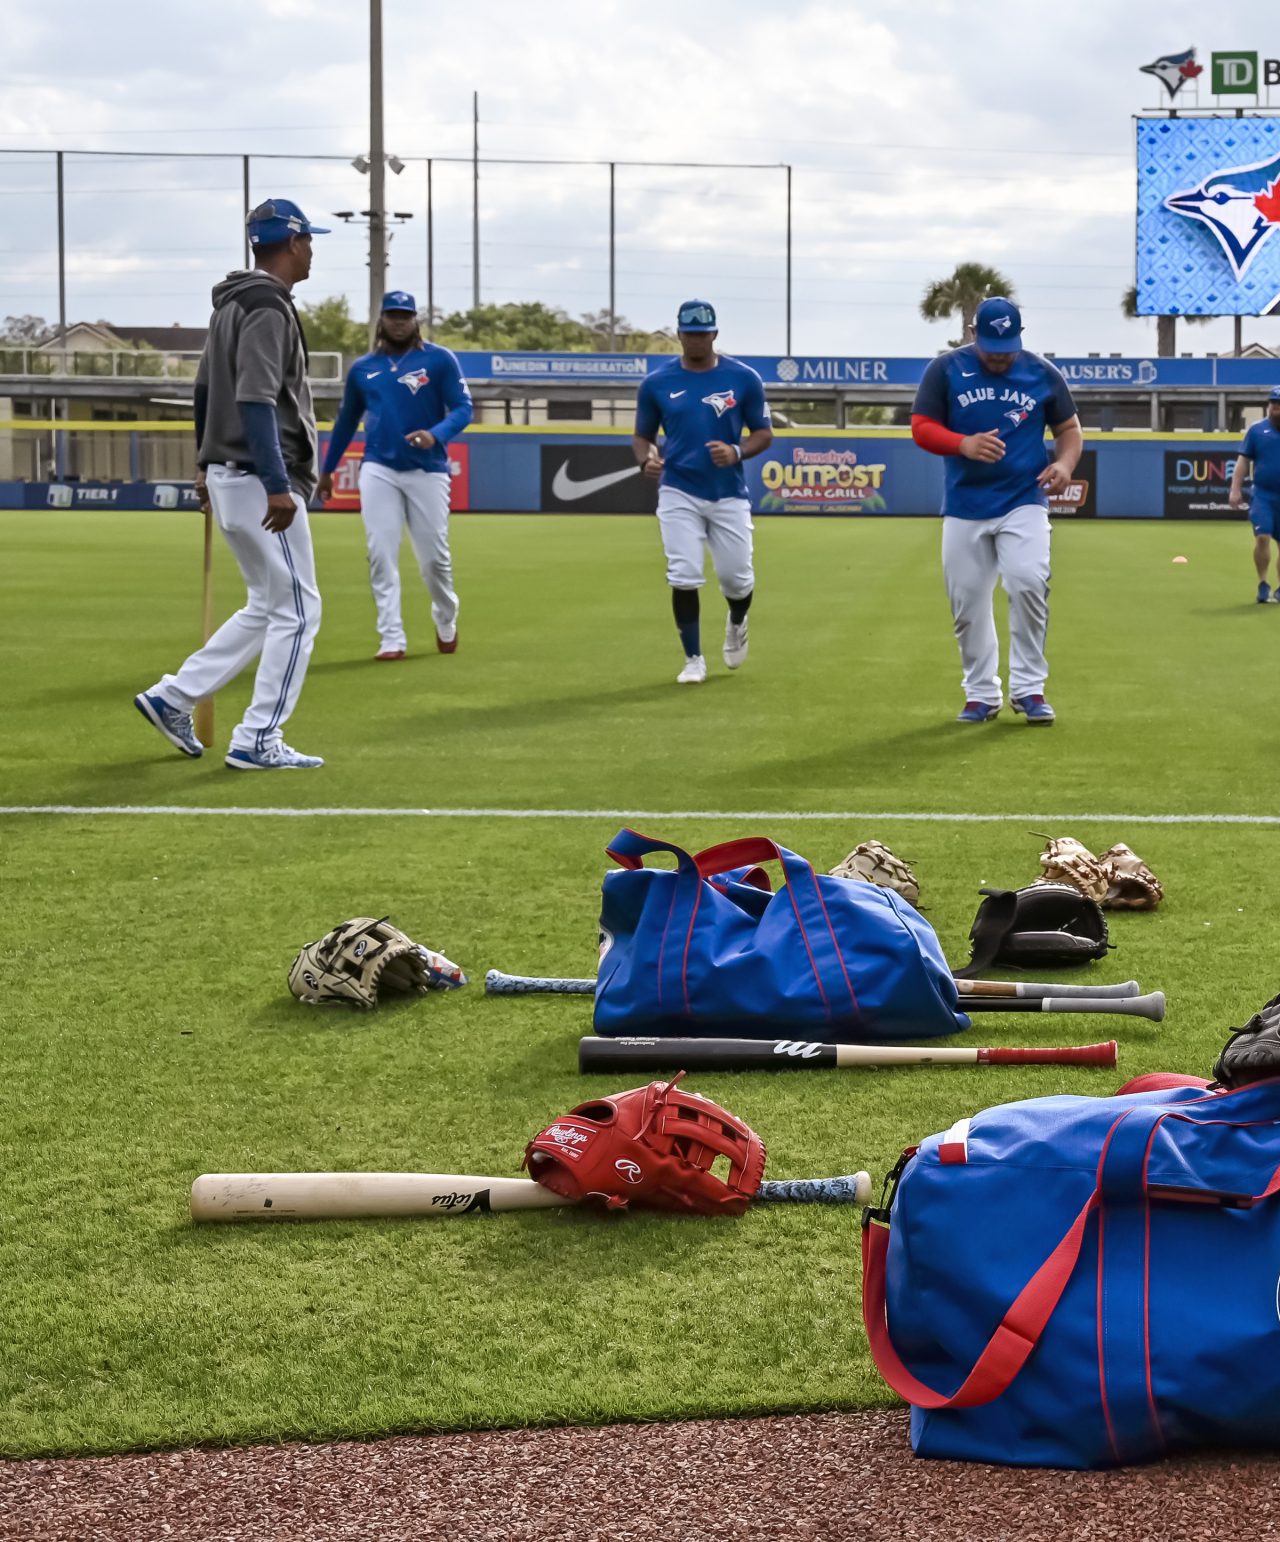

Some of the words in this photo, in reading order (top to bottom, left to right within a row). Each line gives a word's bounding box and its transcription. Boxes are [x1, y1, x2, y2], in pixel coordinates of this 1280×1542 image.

[1216, 58, 1253, 86] TD
[803, 360, 888, 381] MILNER
[1060, 364, 1132, 380] AUSER'S
[957, 387, 996, 408] BLUE
[999, 389, 1036, 411] JAYS
[761, 460, 887, 490] OUTPOST
[76, 489, 109, 500] TIER
[111, 488, 118, 500] 1
[781, 488, 813, 498] BAR
[823, 488, 865, 498] GRILL
[545, 1126, 588, 1144] Rawlings
